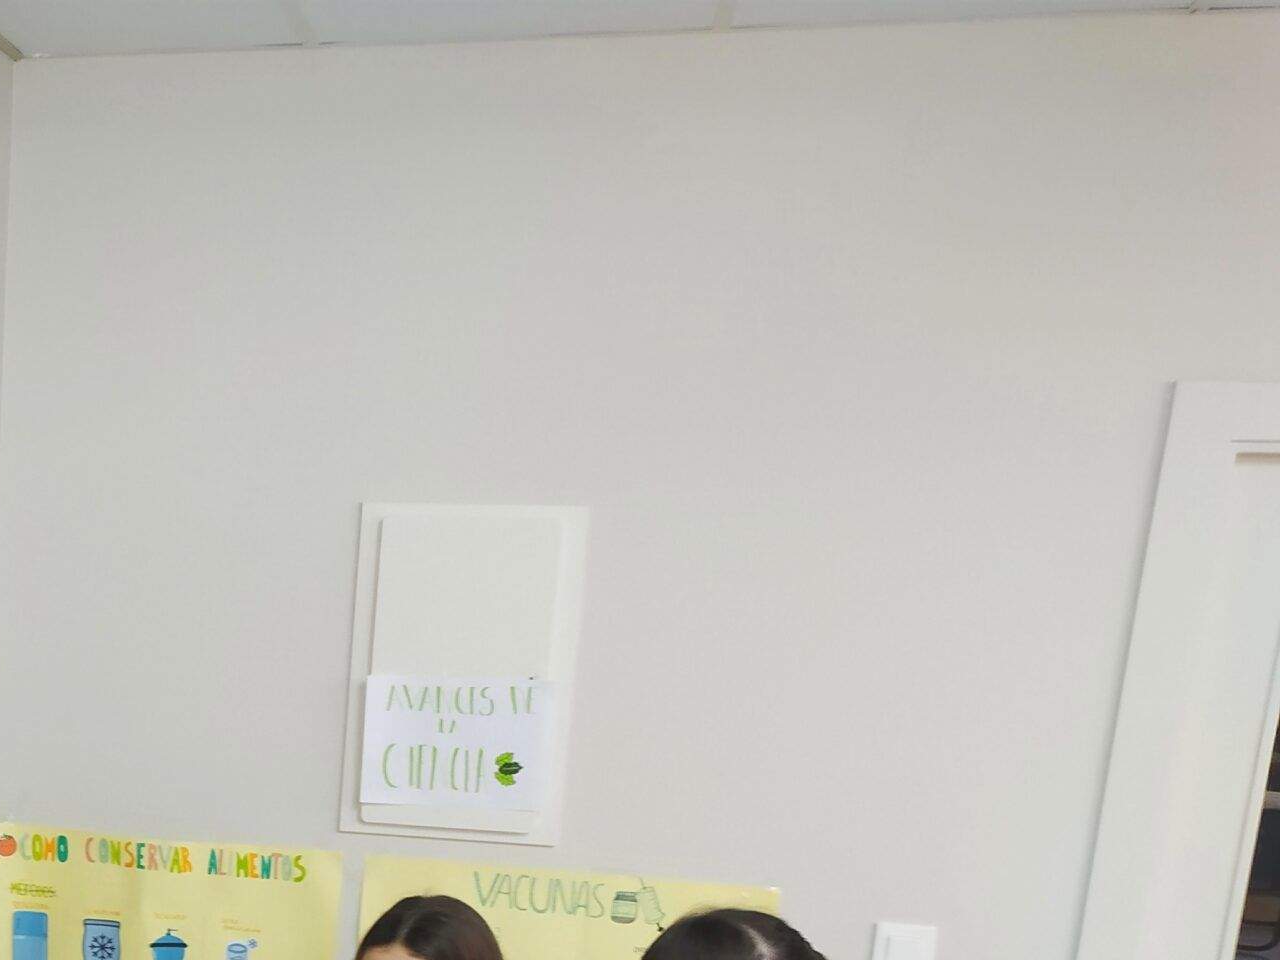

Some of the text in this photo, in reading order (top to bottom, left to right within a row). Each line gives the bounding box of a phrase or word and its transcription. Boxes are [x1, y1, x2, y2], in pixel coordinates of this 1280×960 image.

[20, 833, 307, 883] COMO CONSERVAR ALIMENTOS
[472, 870, 606, 919] VACUNAS
